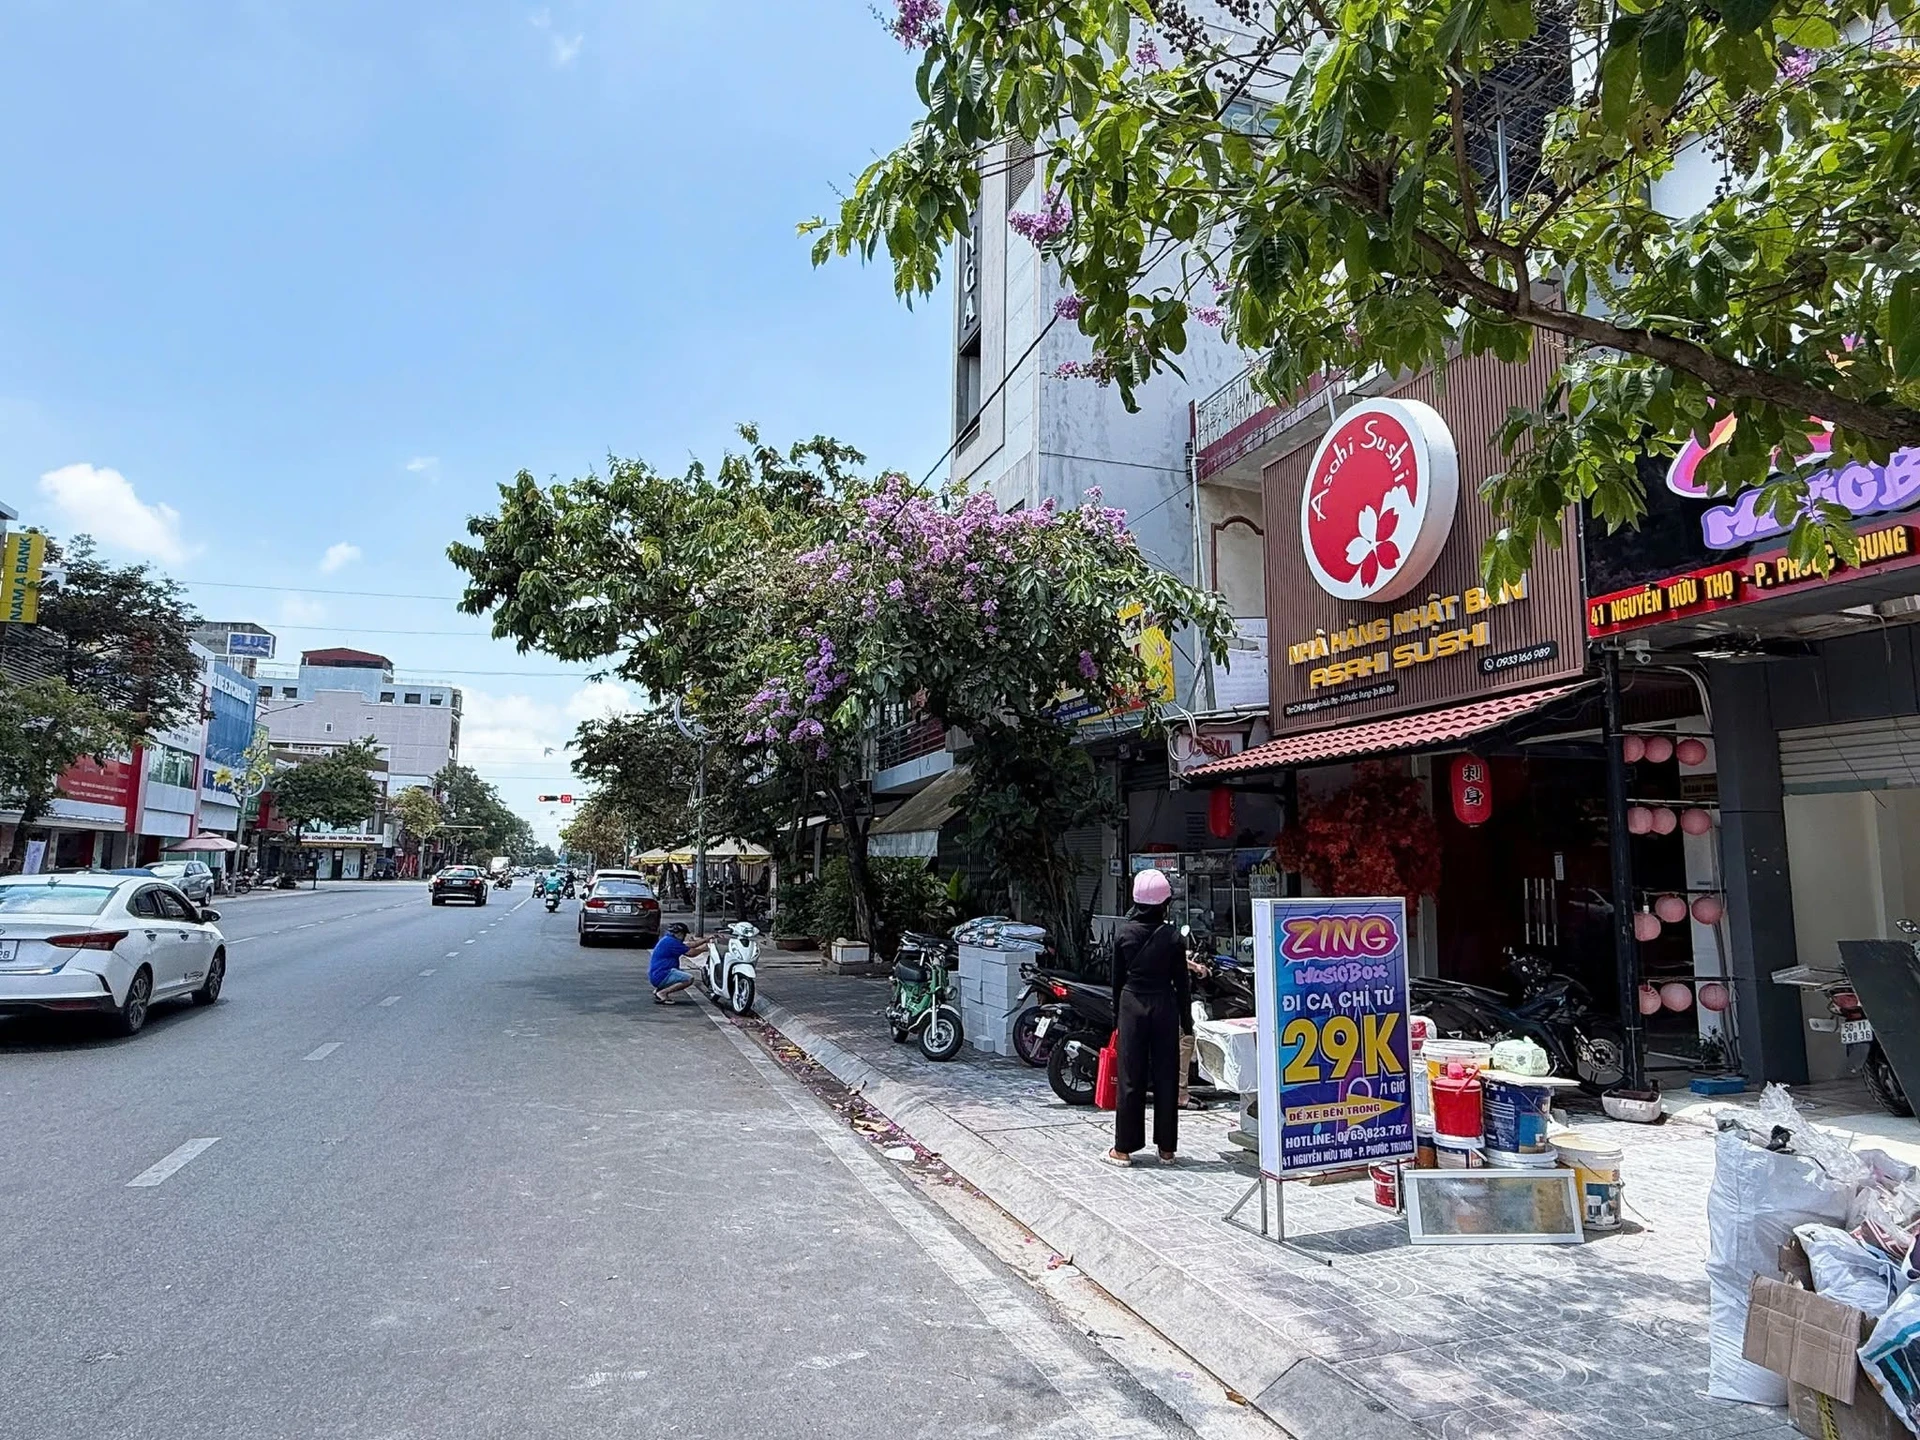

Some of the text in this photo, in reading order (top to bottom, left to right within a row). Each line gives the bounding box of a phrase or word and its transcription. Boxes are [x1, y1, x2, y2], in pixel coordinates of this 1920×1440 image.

[1310, 420, 1410, 522] Asahi Sushi
[1590, 604, 1605, 626] 41
[1611, 584, 1662, 622] NGUYỄN
[1668, 578, 1698, 608] HỮU
[1704, 571, 1734, 600] THỌ
[1755, 562, 1773, 587] P.
[1852, 525, 1908, 563] RUNG
[10, 588, 26, 621] NAM
[1289, 572, 1529, 665] NHÀ HÀNG NHẬT BN
[1310, 651, 1390, 690] ASAHI
[1393, 621, 1491, 669] SUSHI
[1496, 653, 1518, 668] 0933
[1462, 764, 1485, 806] 刺身
[1285, 917, 1392, 957] ZING
[1282, 985, 1395, 1012] ĐI CA CHỈ TỪ
[1281, 1012, 1405, 1085] 29K
[1305, 1110, 1320, 1121] XE
[1322, 1105, 1344, 1118] BÊN
[1346, 1103, 1381, 1115] TRONG
[1285, 1133, 1335, 1149] HOTLINE:
[1339, 1147, 1353, 1160] THỌ
